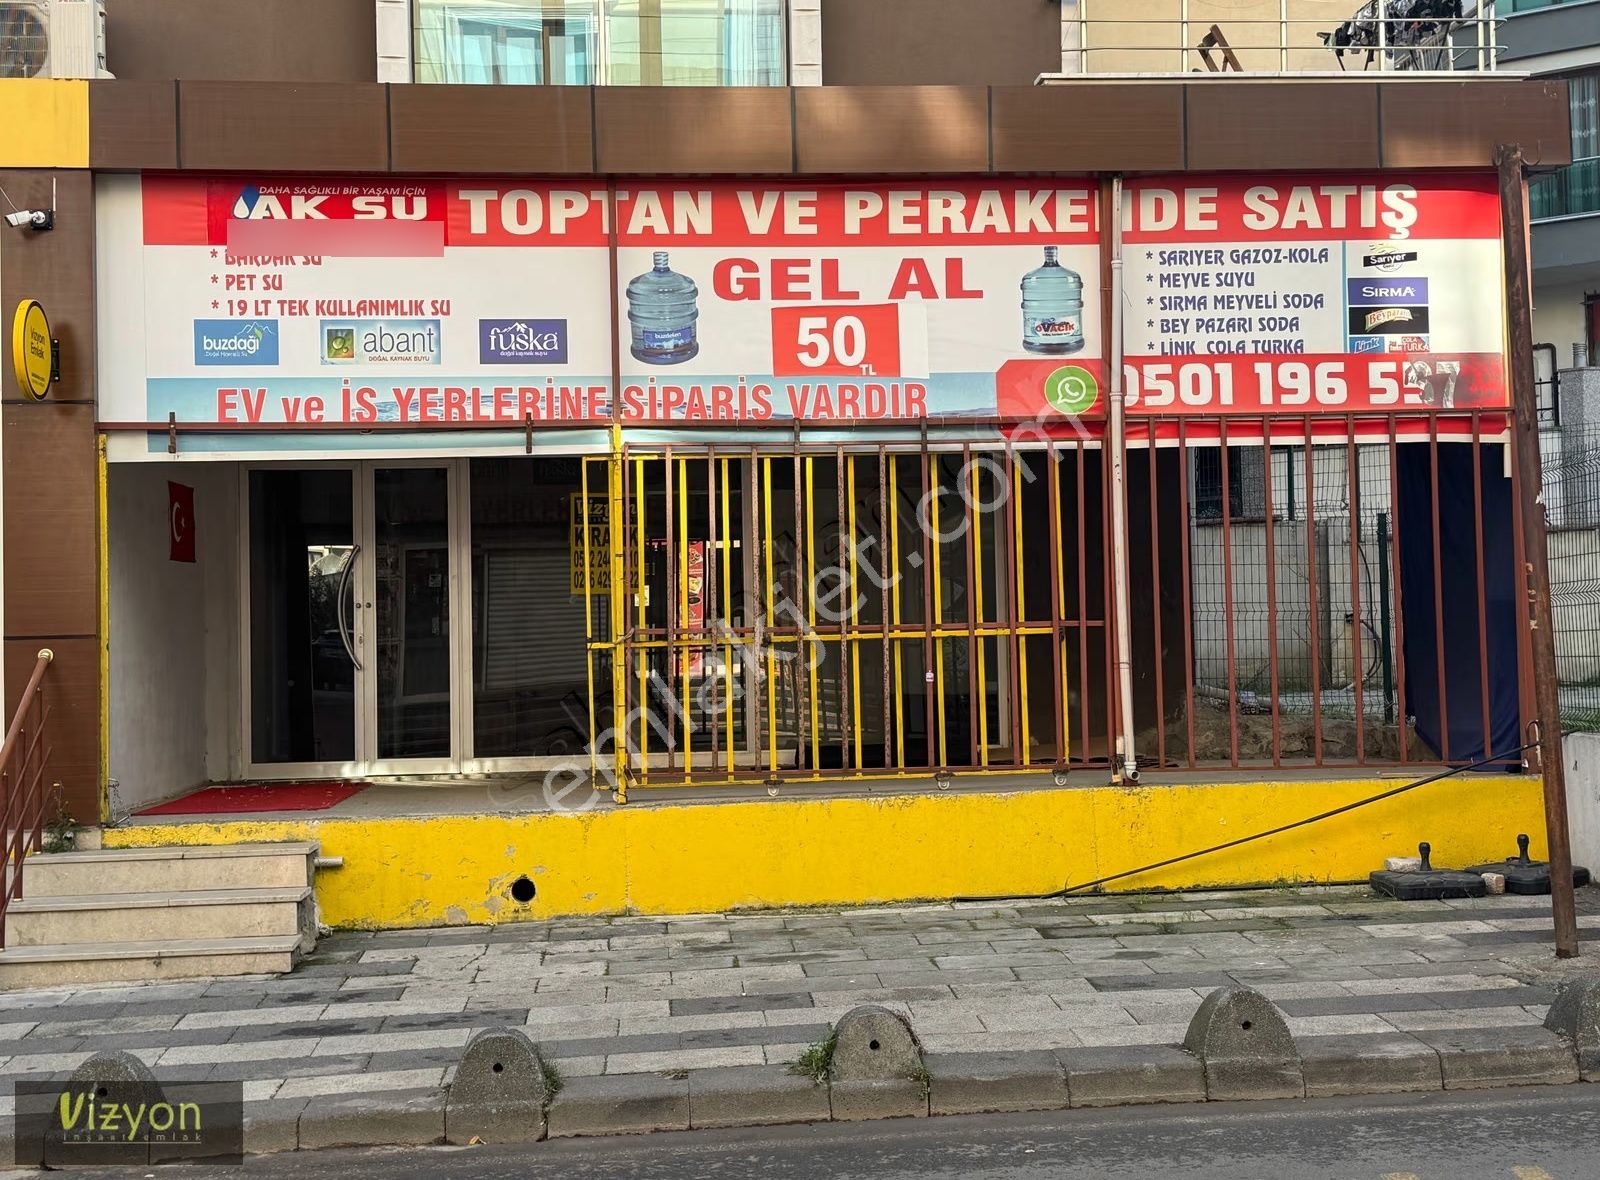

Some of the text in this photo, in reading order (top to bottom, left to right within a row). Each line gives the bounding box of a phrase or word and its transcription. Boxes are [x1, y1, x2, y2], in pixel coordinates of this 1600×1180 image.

[259, 185, 426, 197] DAHA SAĞLIKLI BİR YAŞAM İÇİN
[248, 195, 428, 221] AK SU
[458, 189, 713, 235] TOPTAN
[736, 190, 818, 235] VE
[1242, 184, 1418, 239] SATIŞ
[1159, 247, 1329, 266] SARIYER GAZOZ-KOLA
[225, 274, 283, 291] PET SU
[712, 257, 984, 301] GEL AL
[1159, 271, 1255, 289] MEYVE SUYU
[226, 299, 451, 317] 19 LT TEK KULLANIMLIK SU
[1160, 290, 1325, 311] SIRMA MEYVELİ SODA
[1160, 316, 1300, 333] BEY PAZARI SODA
[203, 335, 260, 354] buzdağı
[363, 326, 434, 353] abant
[796, 315, 867, 368] 50
[1160, 338, 1304, 354] LİNK COLA TURKA
[859, 364, 877, 376] TL
[1253, 362, 1349, 405] 196
[216, 387, 268, 422] EV
[281, 394, 325, 422] ve
[392, 377, 607, 422] YERLERİNE
[787, 383, 928, 420] VARDIR
